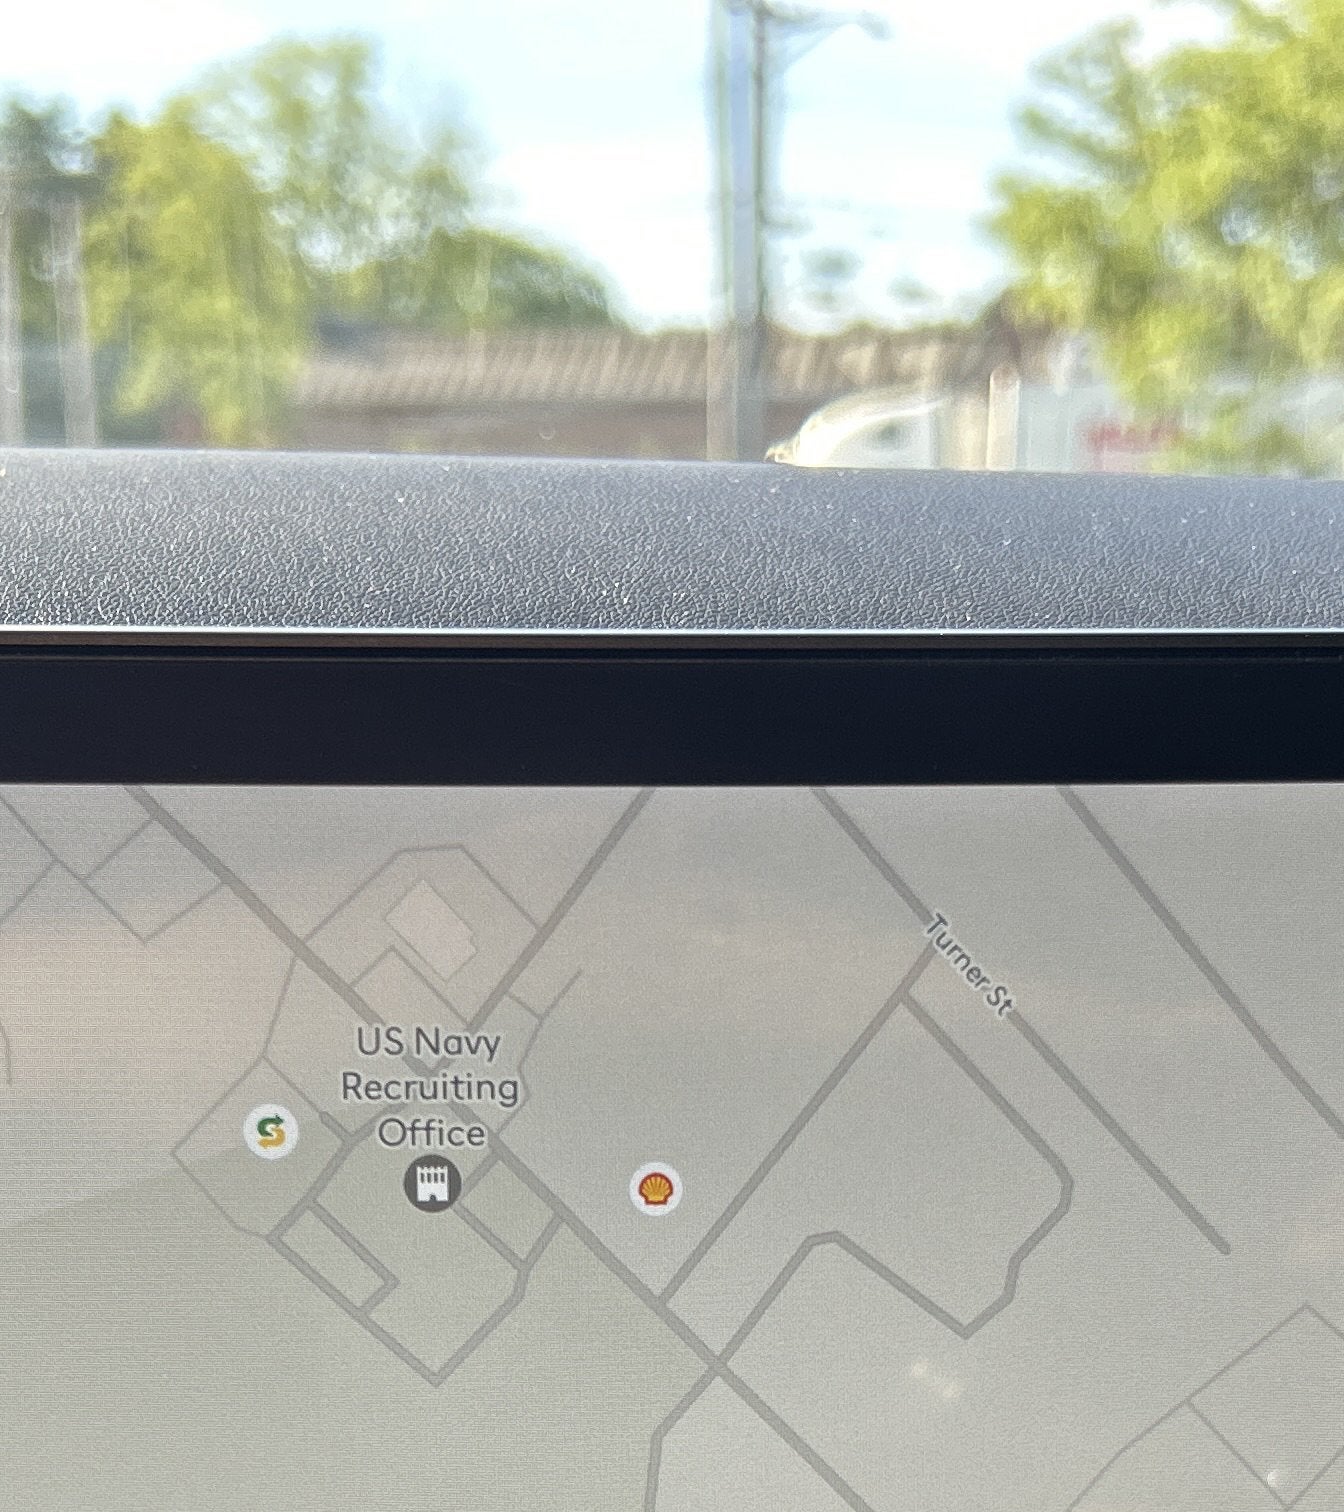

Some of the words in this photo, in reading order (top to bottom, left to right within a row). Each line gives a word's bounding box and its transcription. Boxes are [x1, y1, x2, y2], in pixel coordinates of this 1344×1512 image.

[926, 912, 991, 989] Turner
[986, 985, 1013, 1016] St
[357, 1026, 404, 1057] US
[415, 1026, 500, 1062] Navy
[341, 1071, 519, 1108] Recruiting
[378, 1117, 486, 1147] Office
